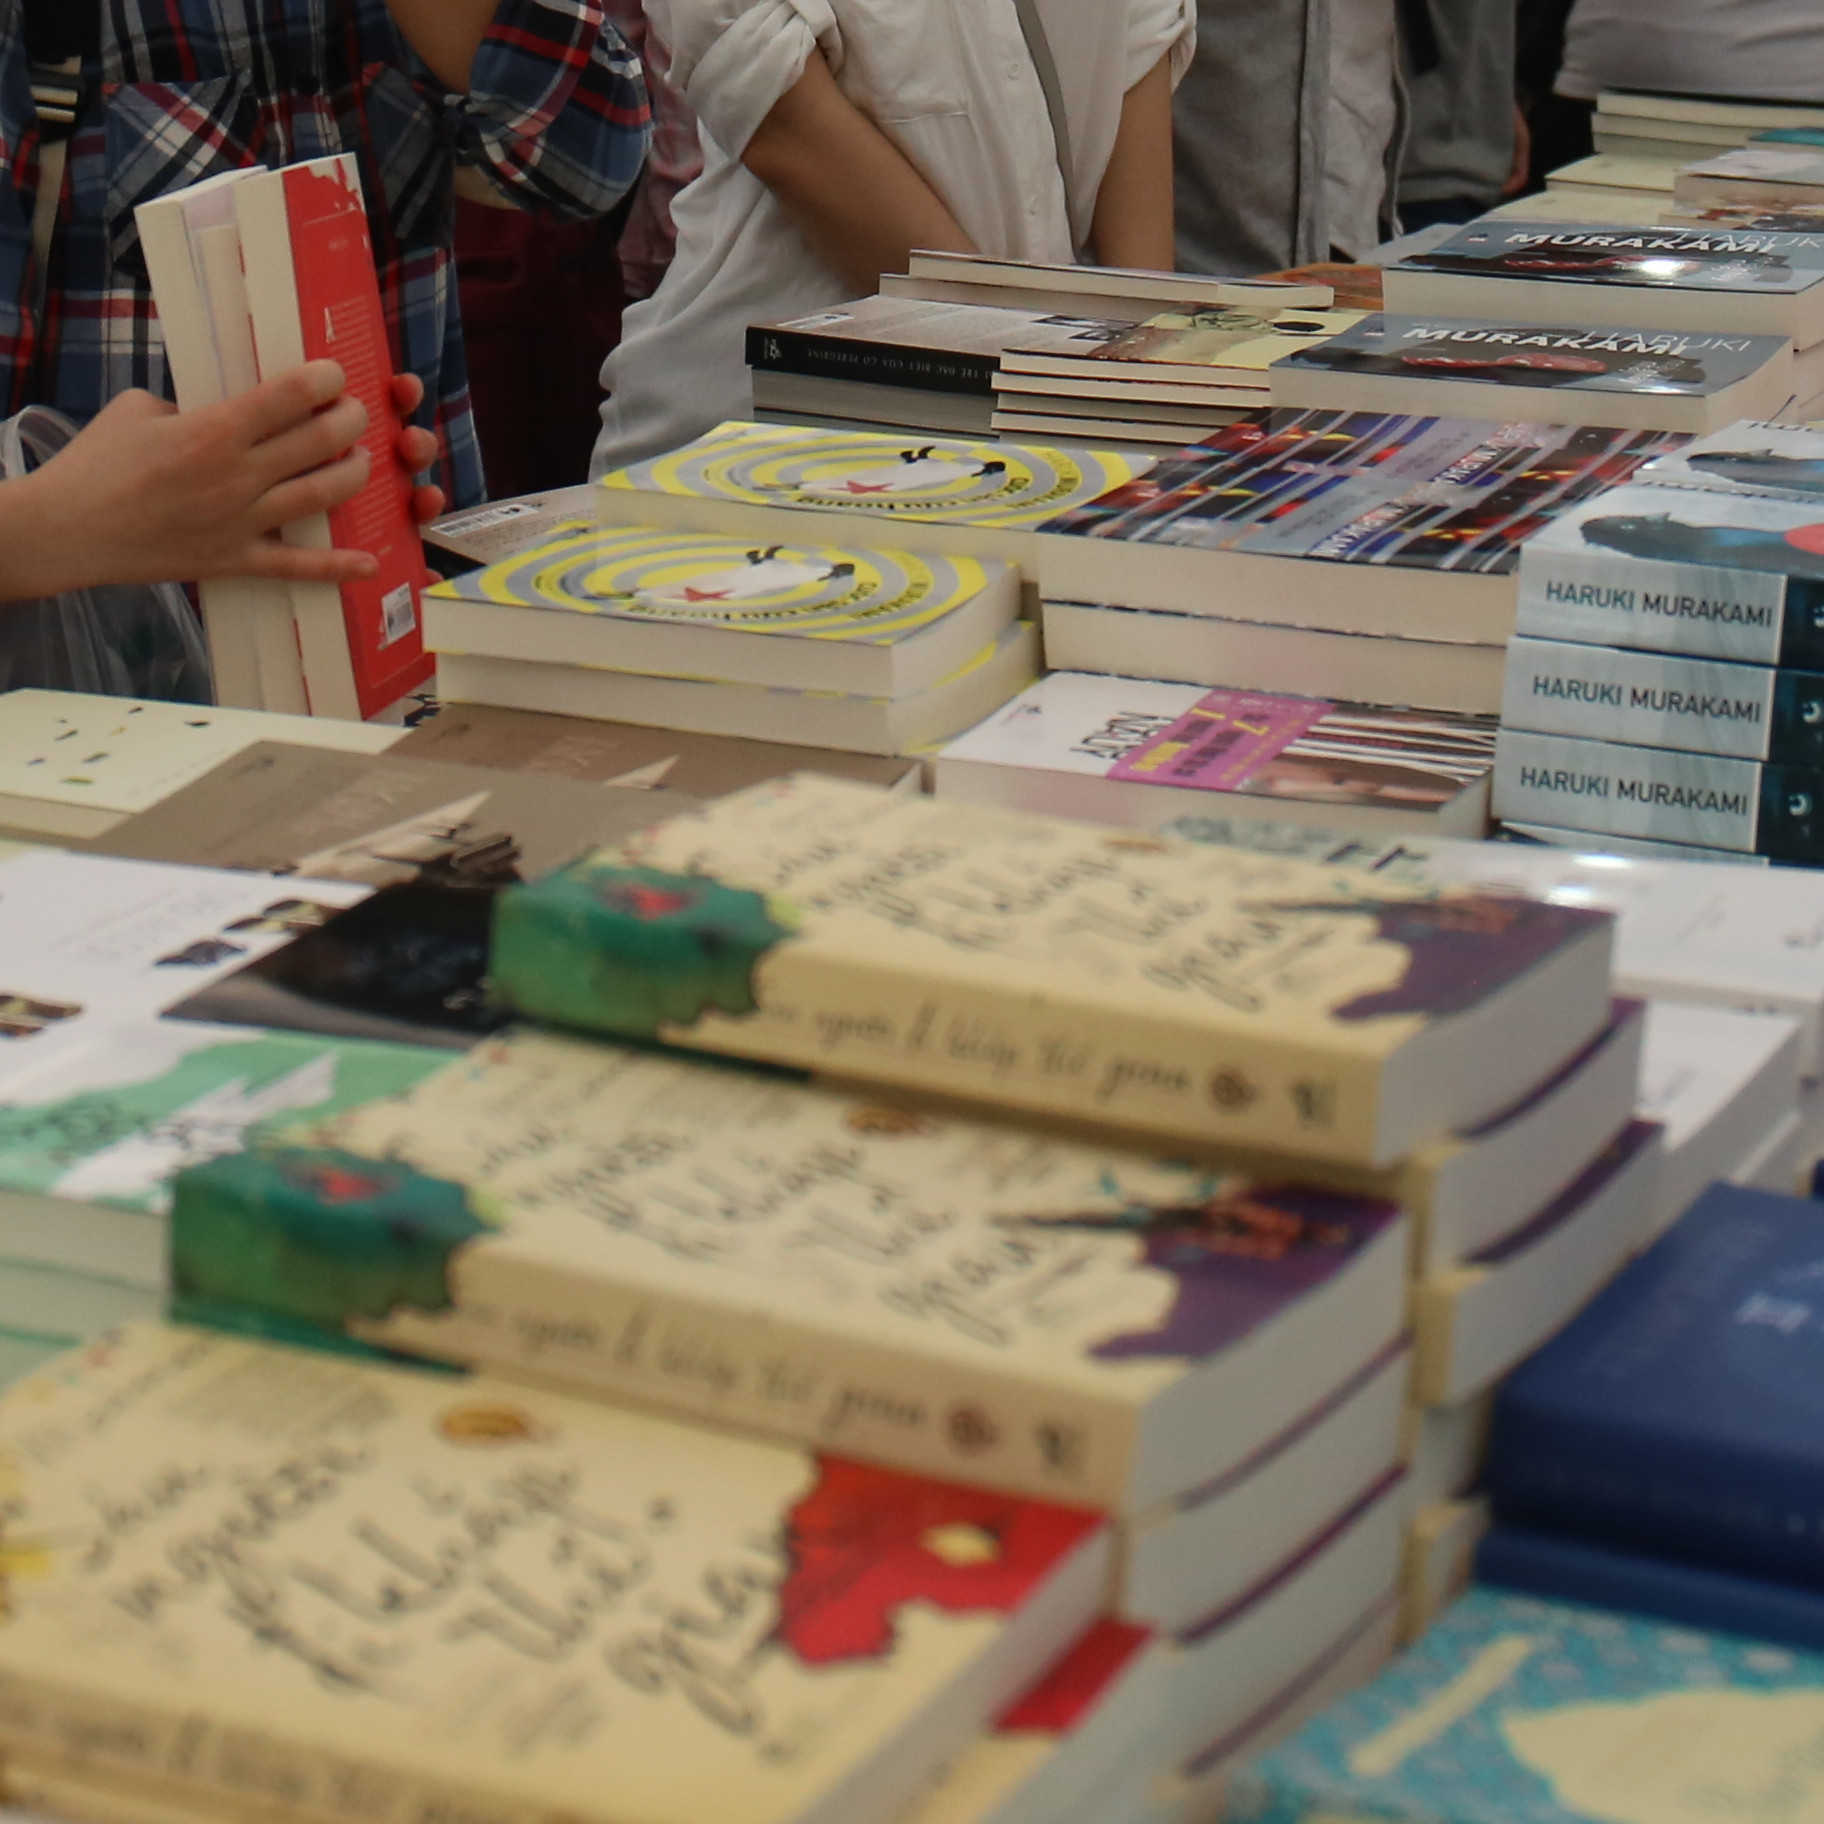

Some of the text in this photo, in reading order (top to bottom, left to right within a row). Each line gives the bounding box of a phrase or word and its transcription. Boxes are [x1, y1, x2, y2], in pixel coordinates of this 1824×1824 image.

[1504, 231, 1776, 257] MURAKAMI
[1402, 327, 1694, 358] MURAKAMI
[1545, 580, 1772, 628] HARUKI MURAKAMI
[1533, 675, 1762, 723] HARUKI MURAKAMI
[1520, 767, 1748, 816] HARUKI MURAKAMI
